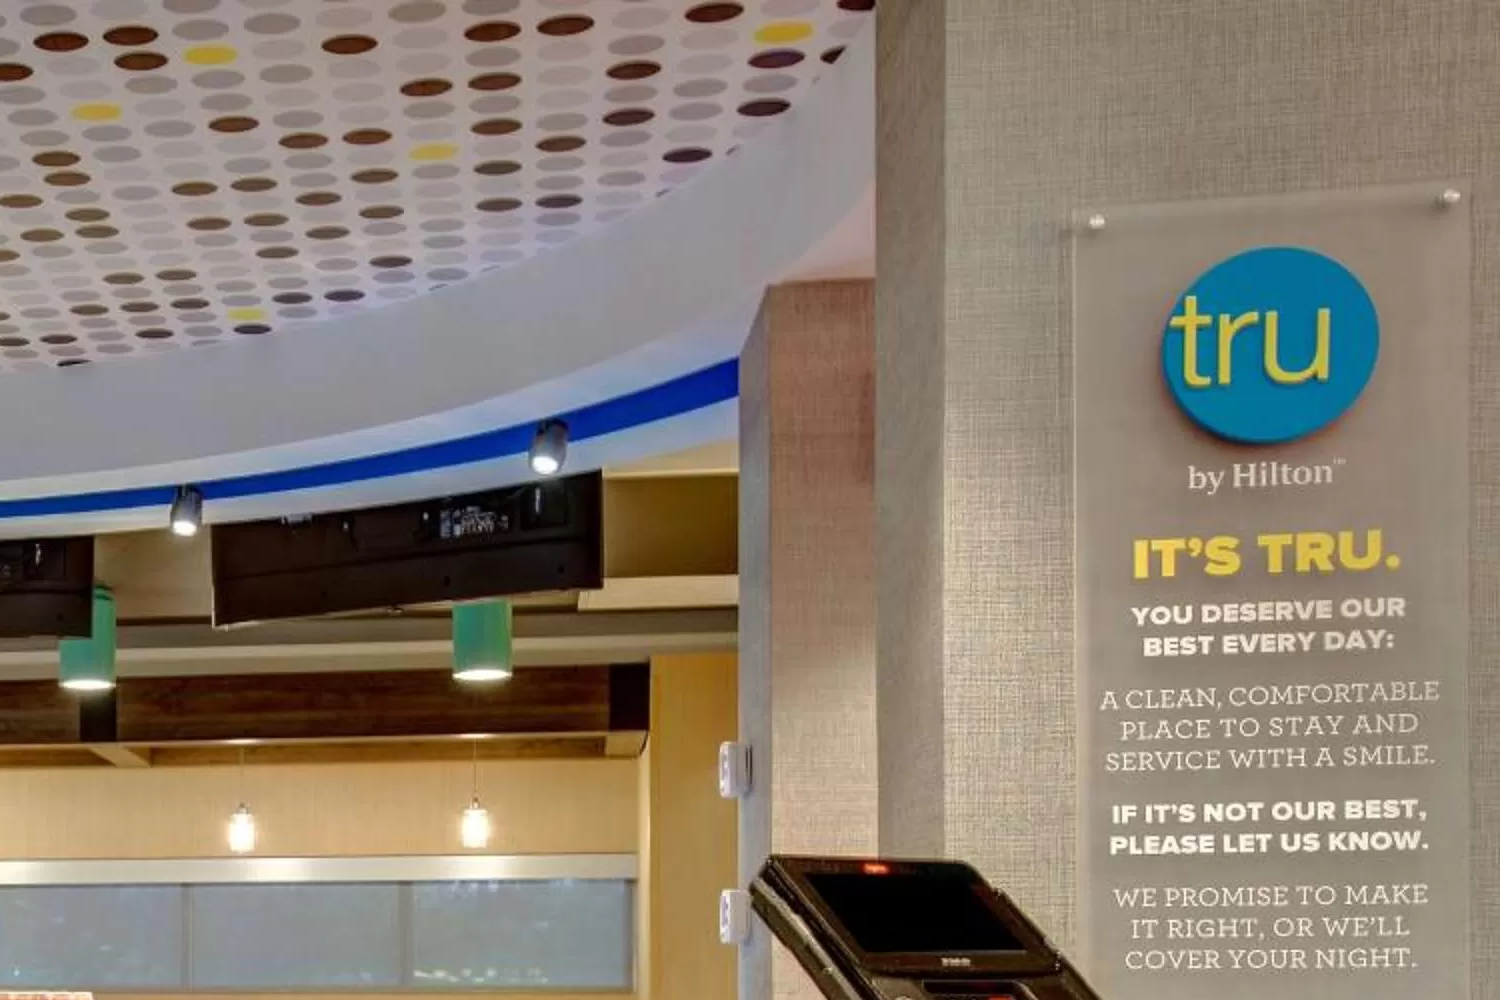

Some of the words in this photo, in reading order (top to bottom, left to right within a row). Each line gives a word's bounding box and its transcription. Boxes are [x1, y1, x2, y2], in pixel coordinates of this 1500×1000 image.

[1170, 295, 1331, 387] tru
[1188, 466, 1224, 494] by
[1132, 537, 1241, 579] IT'S
[1257, 528, 1401, 575] TRU.
[1131, 604, 1193, 626] YOU
[1201, 601, 1333, 623] DESERVE
[1340, 597, 1406, 618] OUR
[1143, 635, 1215, 657] BEST
[1223, 632, 1317, 654] EVERY
[1324, 629, 1395, 651] DAY:
[1100, 691, 1119, 711] A
[1125, 687, 1222, 712] CLEAN,
[1229, 680, 1440, 708] COMFORTABLE
[1120, 719, 1211, 742] PLACE
[1220, 717, 1260, 738] TO
[1269, 715, 1345, 737] STAY
[1352, 713, 1418, 735] AND
[1106, 749, 1221, 772] SERVICE
[1227, 748, 1307, 769] WITH
[1314, 747, 1335, 767] A
[1343, 744, 1436, 767] SMILE.
[1112, 805, 1137, 824] IF
[1145, 803, 1196, 824] IT'S
[1203, 802, 1265, 823] NOT
[1272, 801, 1336, 821] OUR
[1344, 799, 1427, 821] BEST,
[1109, 833, 1215, 855] PLEASE
[1223, 833, 1272, 854] LET
[1280, 832, 1321, 853] US
[1328, 831, 1429, 852] KNOW.
[1113, 888, 1157, 908] WE
[1164, 886, 1289, 908] PROMISE
[1295, 885, 1336, 906] TO
[1344, 884, 1429, 905] MAKE
[1131, 919, 1158, 939] IT
[1167, 918, 1264, 941] RIGHT,
[1273, 917, 1314, 938] OR
[1322, 916, 1410, 937] WE'LL
[1125, 949, 1221, 970] COVER
[1228, 948, 1306, 969] YOUR
[1315, 947, 1417, 969] NIGHT.
